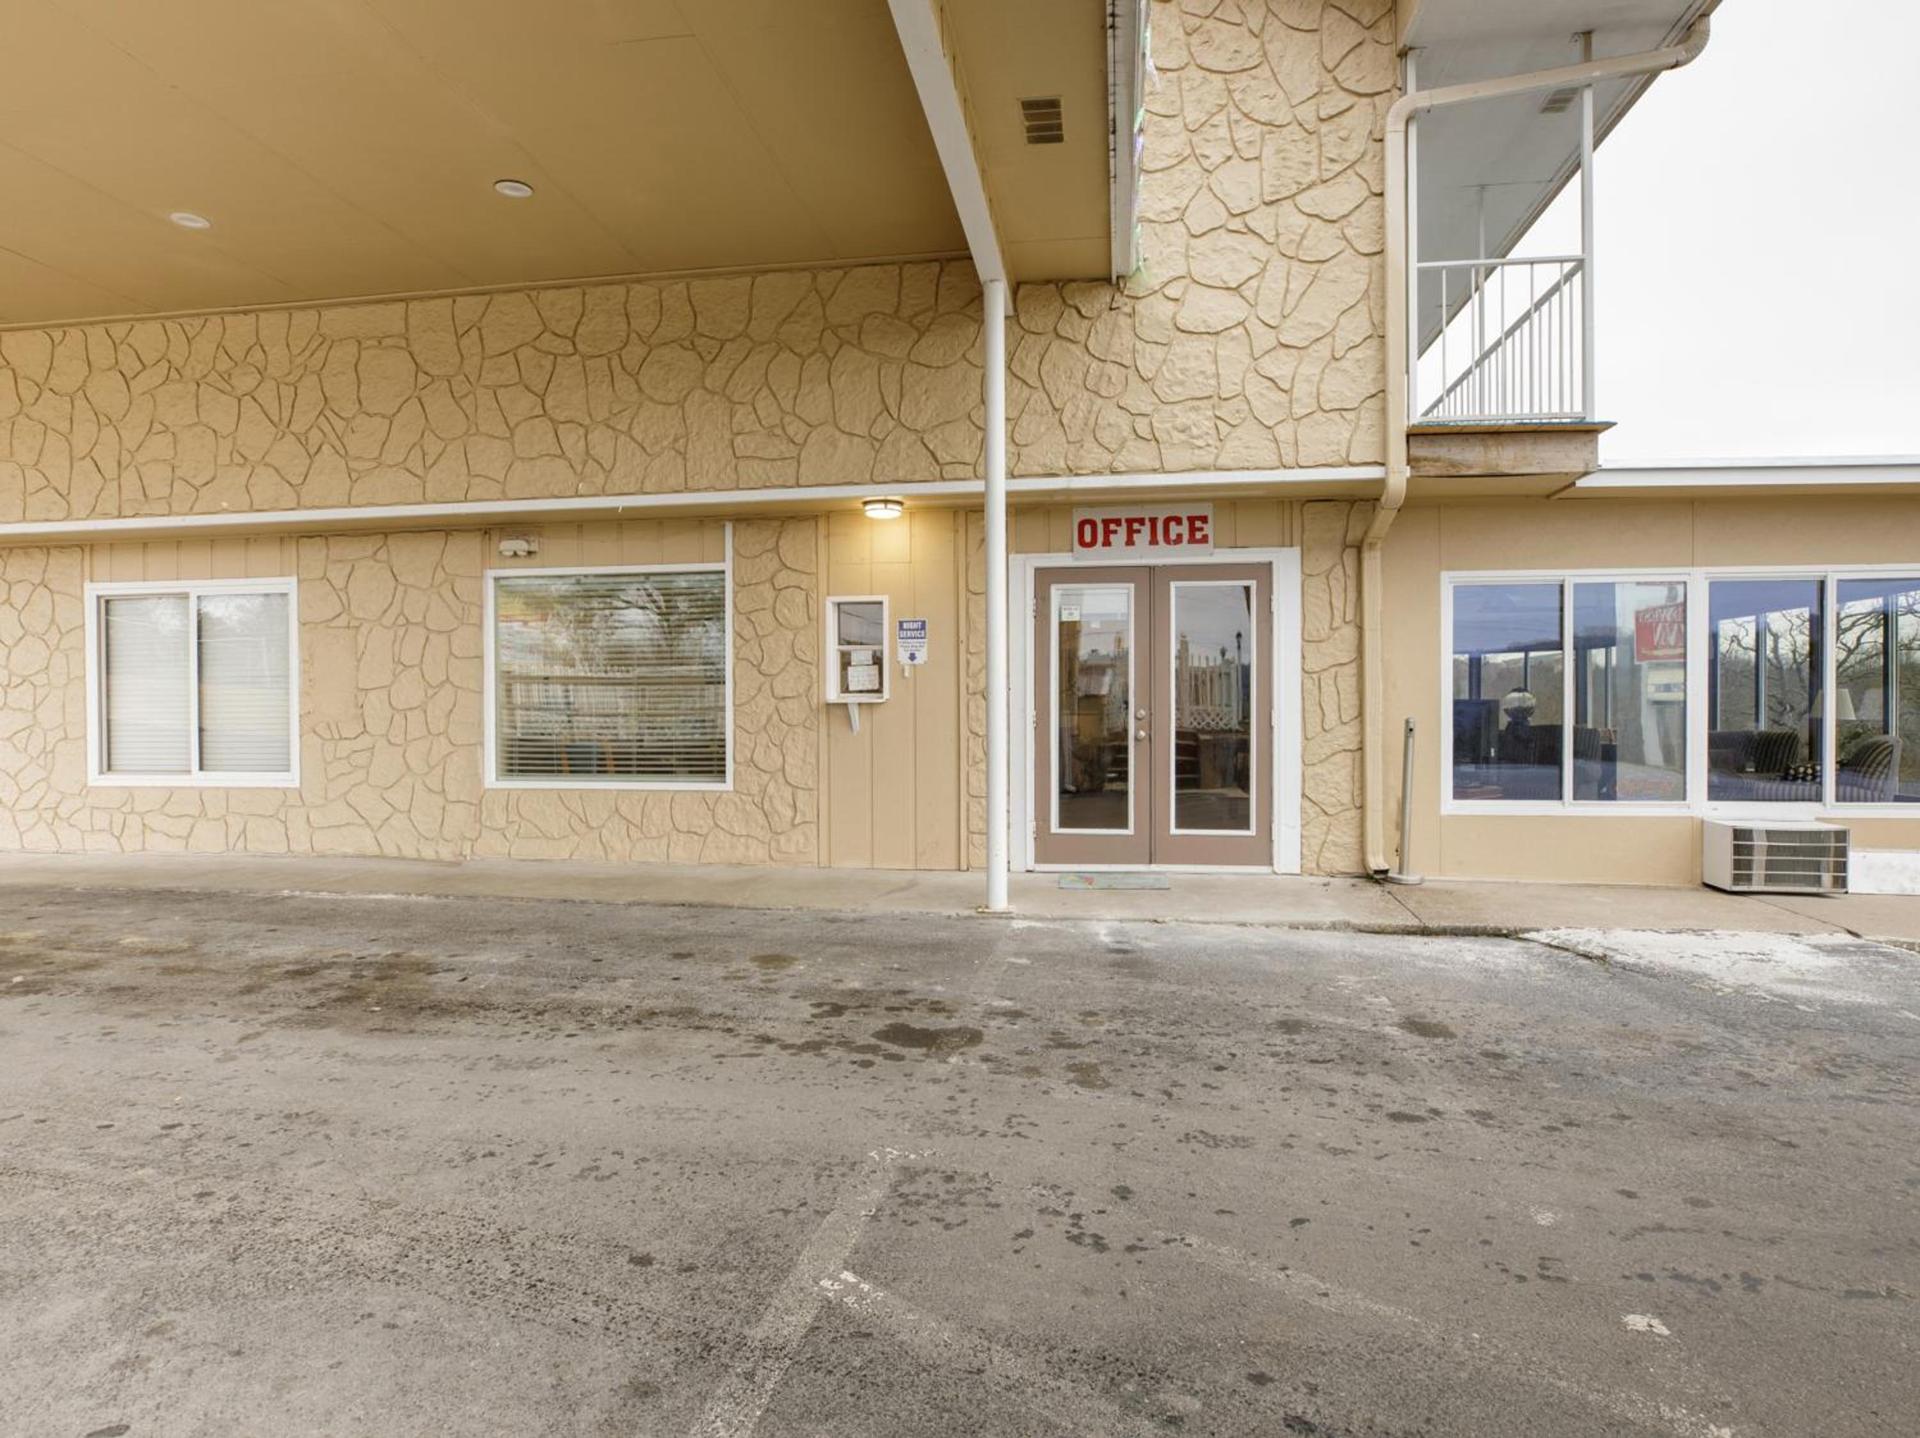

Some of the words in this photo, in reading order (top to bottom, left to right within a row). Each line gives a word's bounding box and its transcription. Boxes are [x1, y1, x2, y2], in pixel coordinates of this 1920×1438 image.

[1077, 515, 1209, 548] OFFICE
[903, 622, 921, 630] NIGHT
[899, 630, 925, 638] SERVICE
